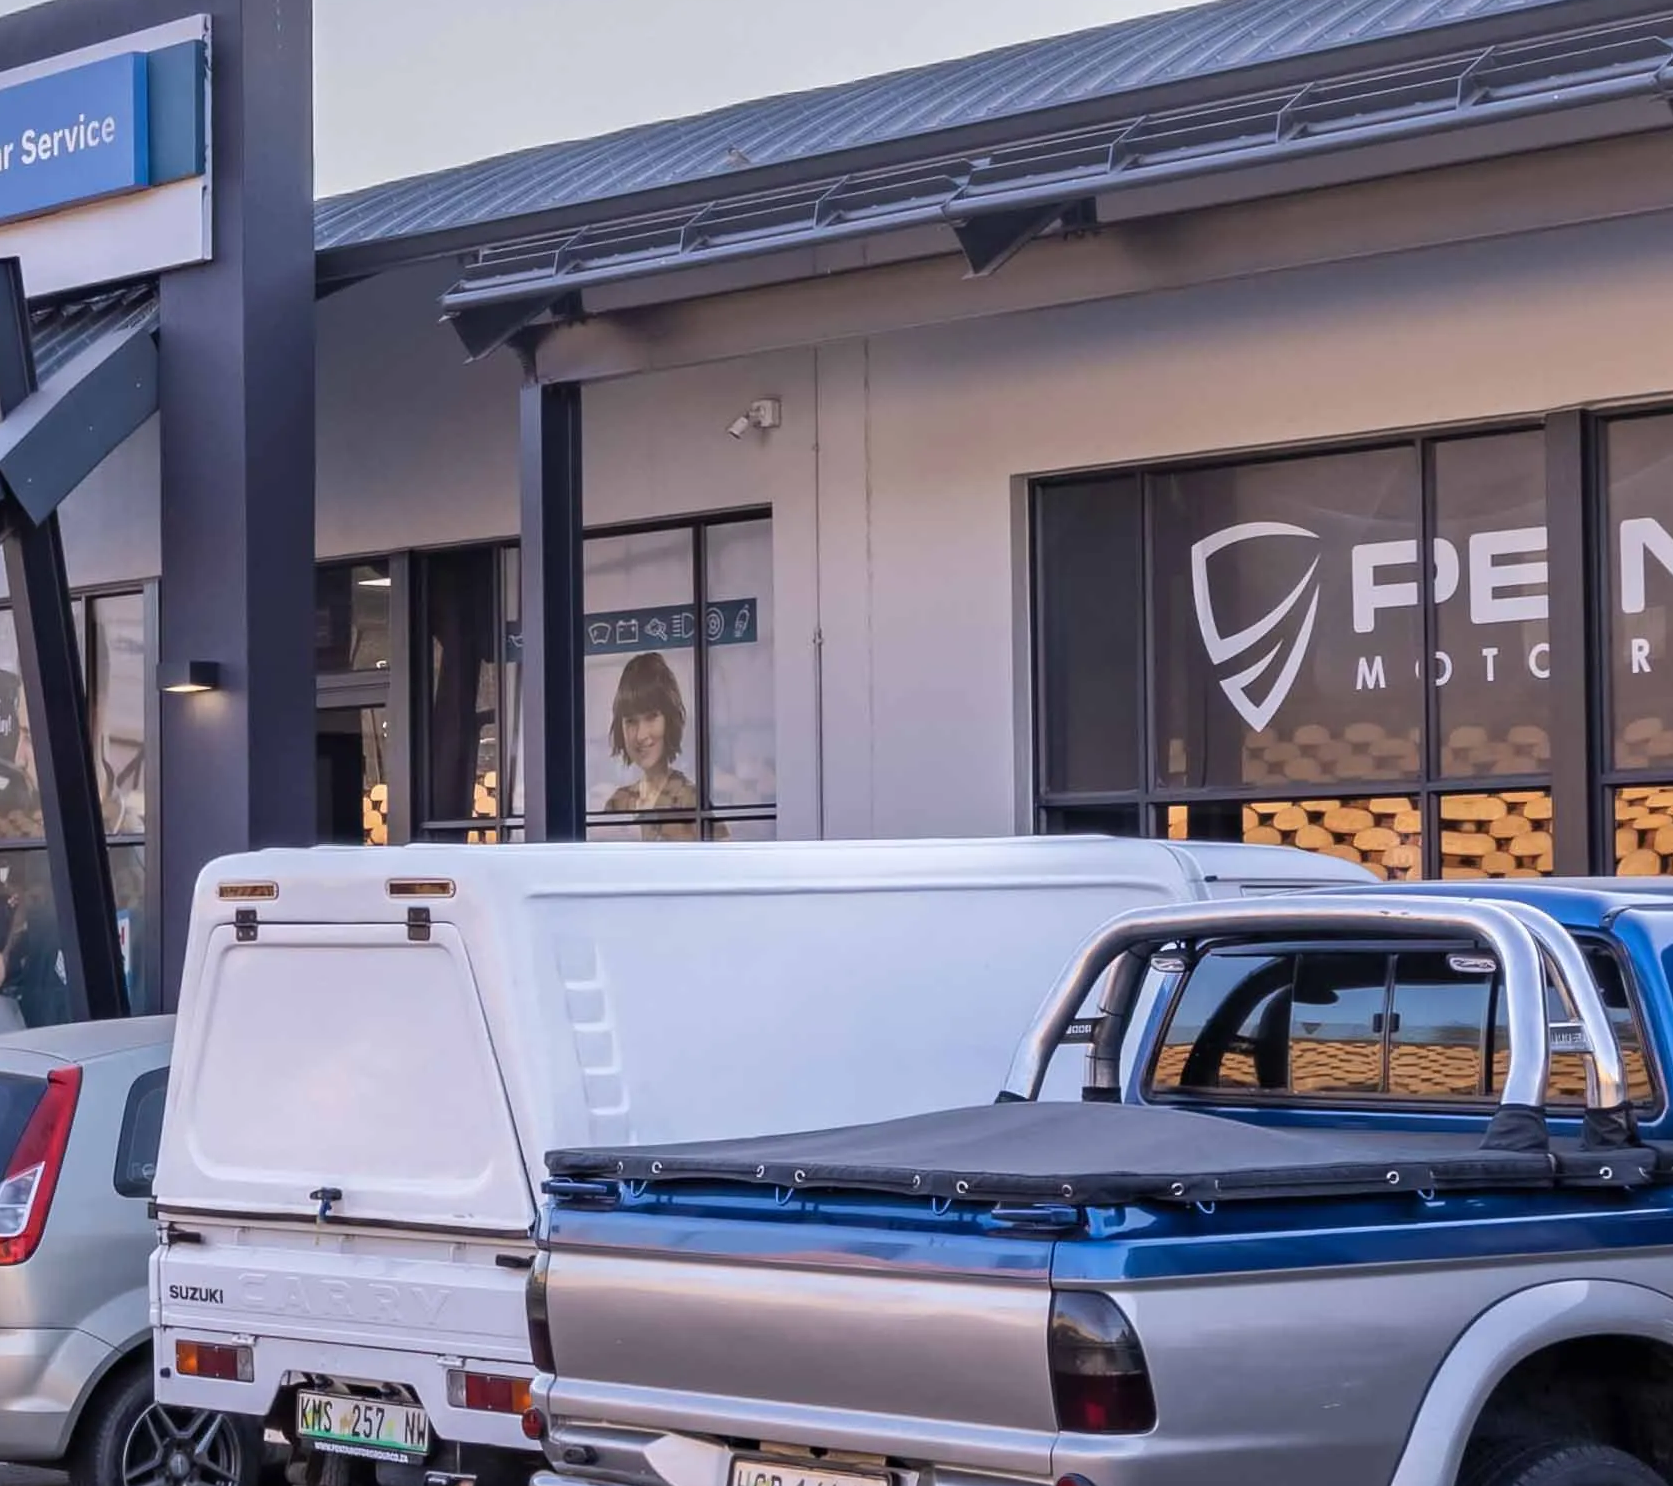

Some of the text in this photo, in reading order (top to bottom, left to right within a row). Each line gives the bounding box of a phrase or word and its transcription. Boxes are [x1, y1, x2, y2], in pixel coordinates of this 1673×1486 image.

[21, 114, 115, 165] Service
[1356, 637, 1652, 689] MOTOR
[169, 1272, 454, 1326] SUZUKI CARRY
[301, 1396, 427, 1446] KMS 257 NW
